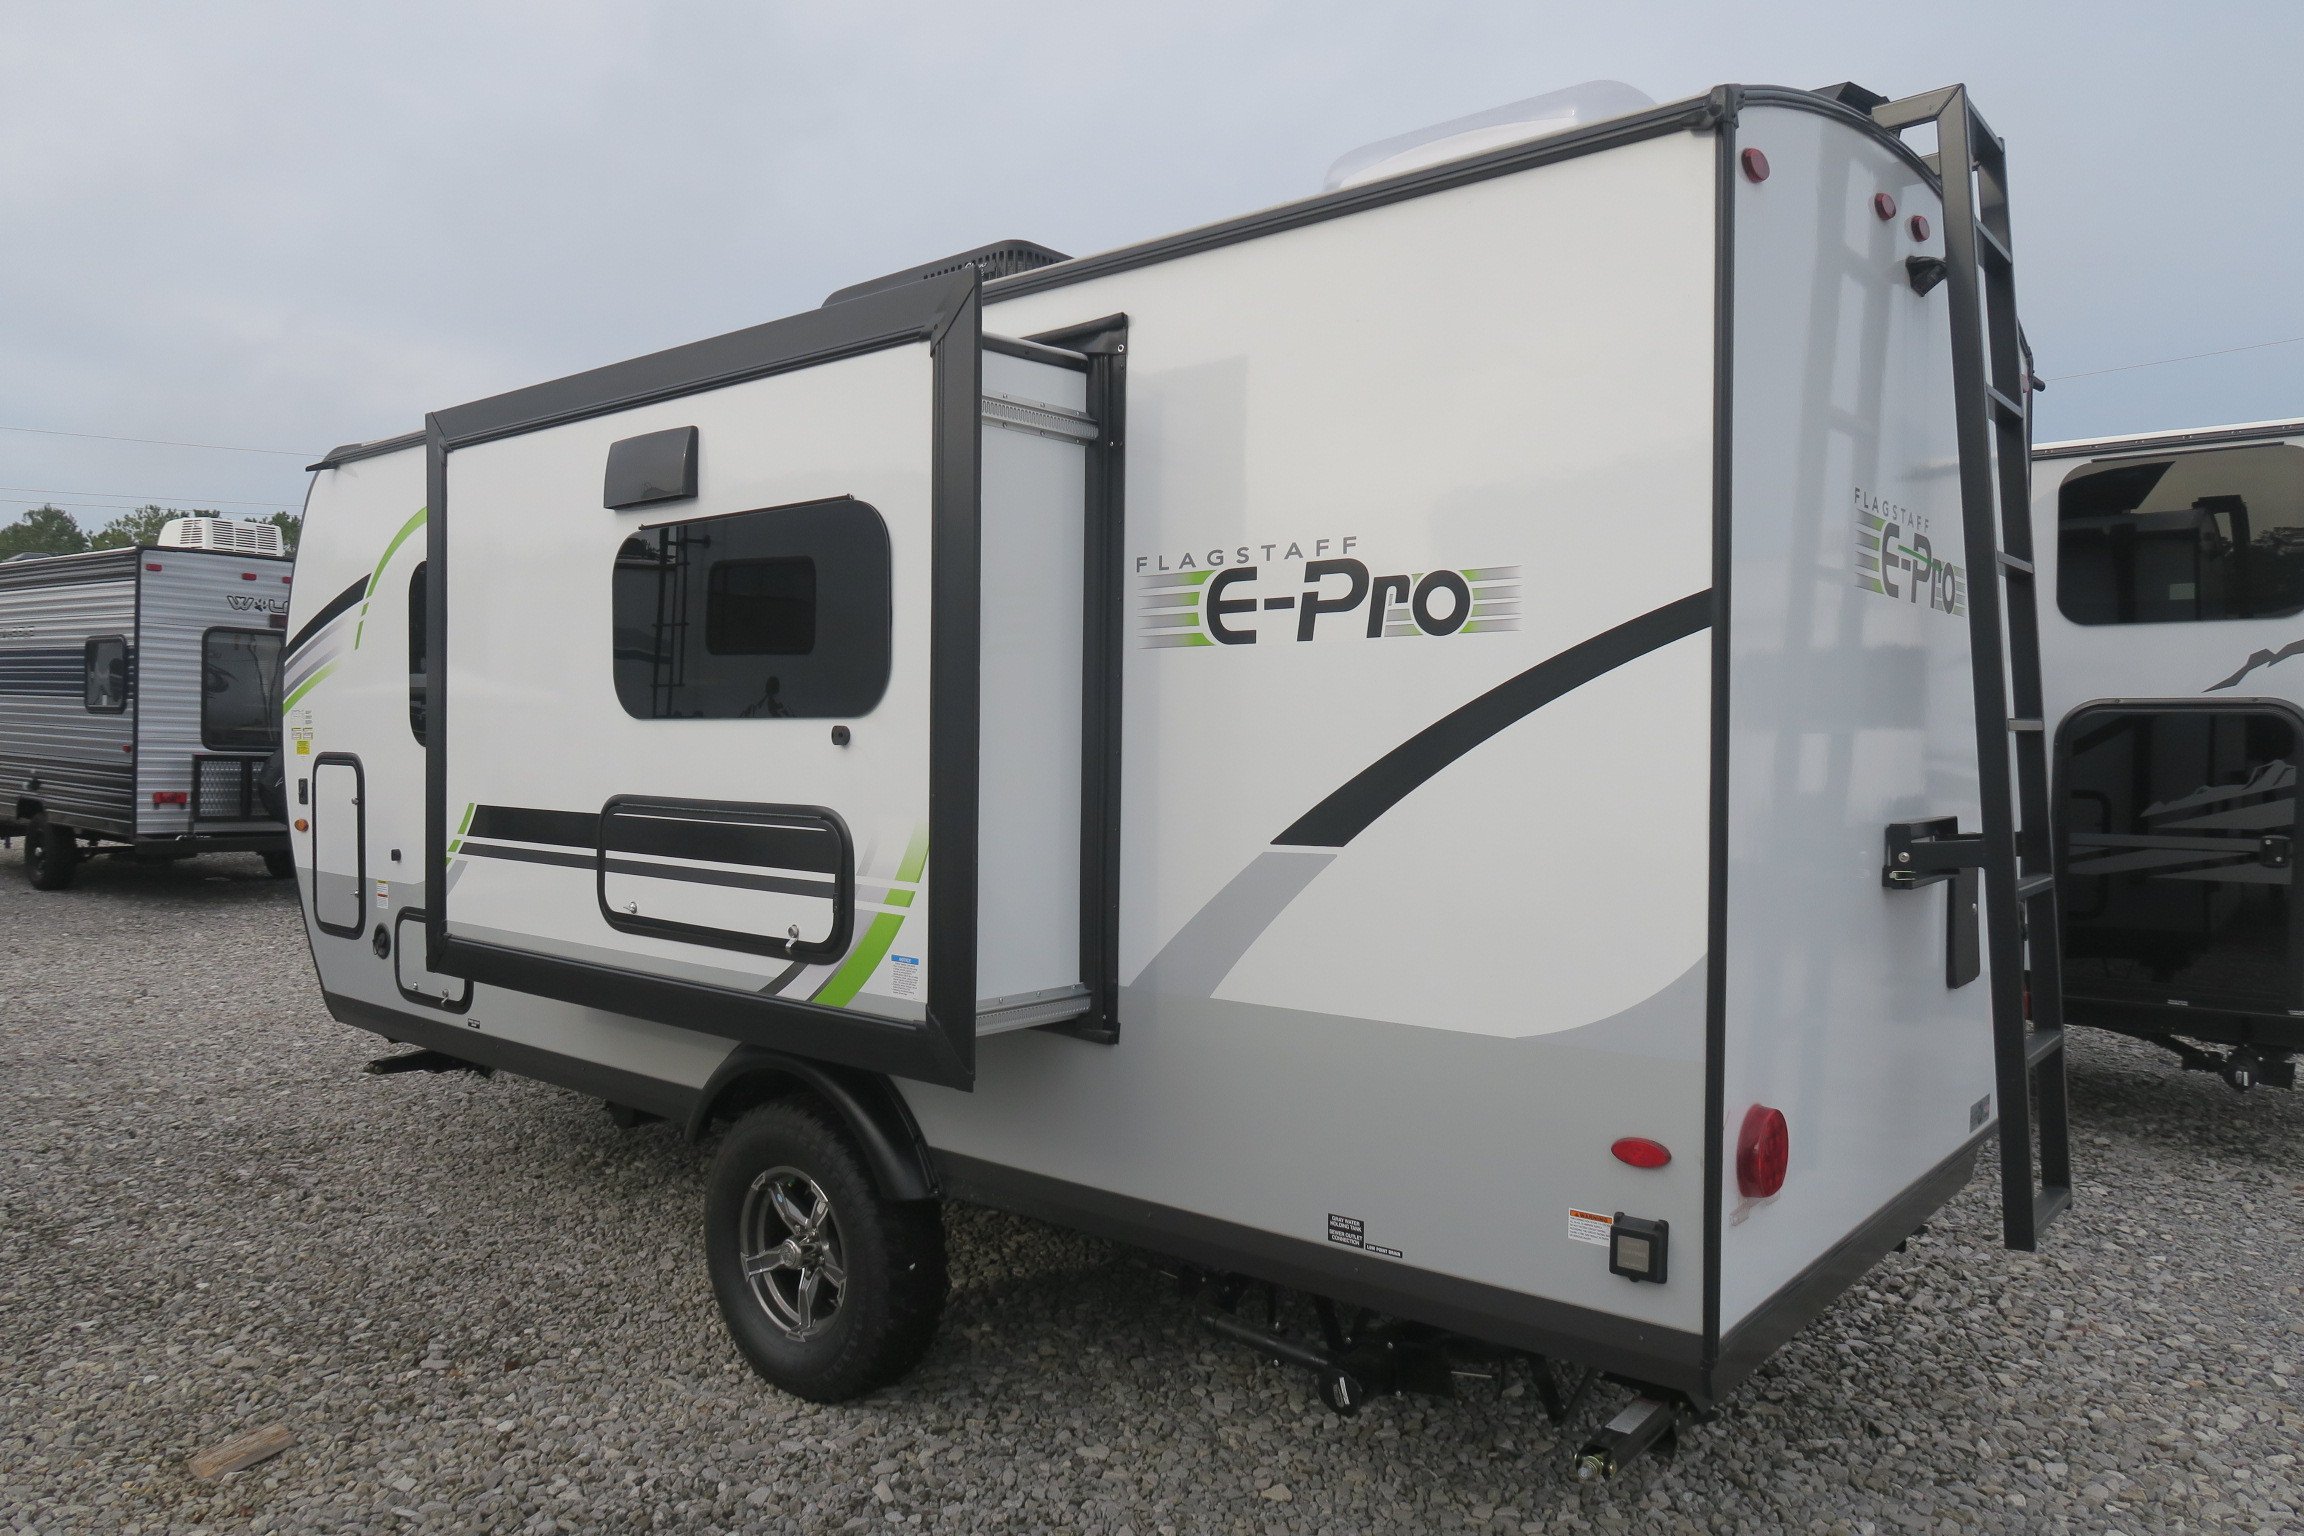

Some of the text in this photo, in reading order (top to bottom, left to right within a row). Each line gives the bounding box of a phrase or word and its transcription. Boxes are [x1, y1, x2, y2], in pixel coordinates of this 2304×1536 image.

[1854, 487, 1929, 533] FLAGSTAFF
[1136, 536, 1357, 573] FLAGSTAFF
[1882, 522, 1955, 614] E-Pro
[1206, 558, 1471, 645] E-Pro
[1329, 1229, 1363, 1241] SEWER OUTLET
[1330, 1221, 1350, 1229] HOLDING
[1331, 1234, 1359, 1245] CONNECTION
